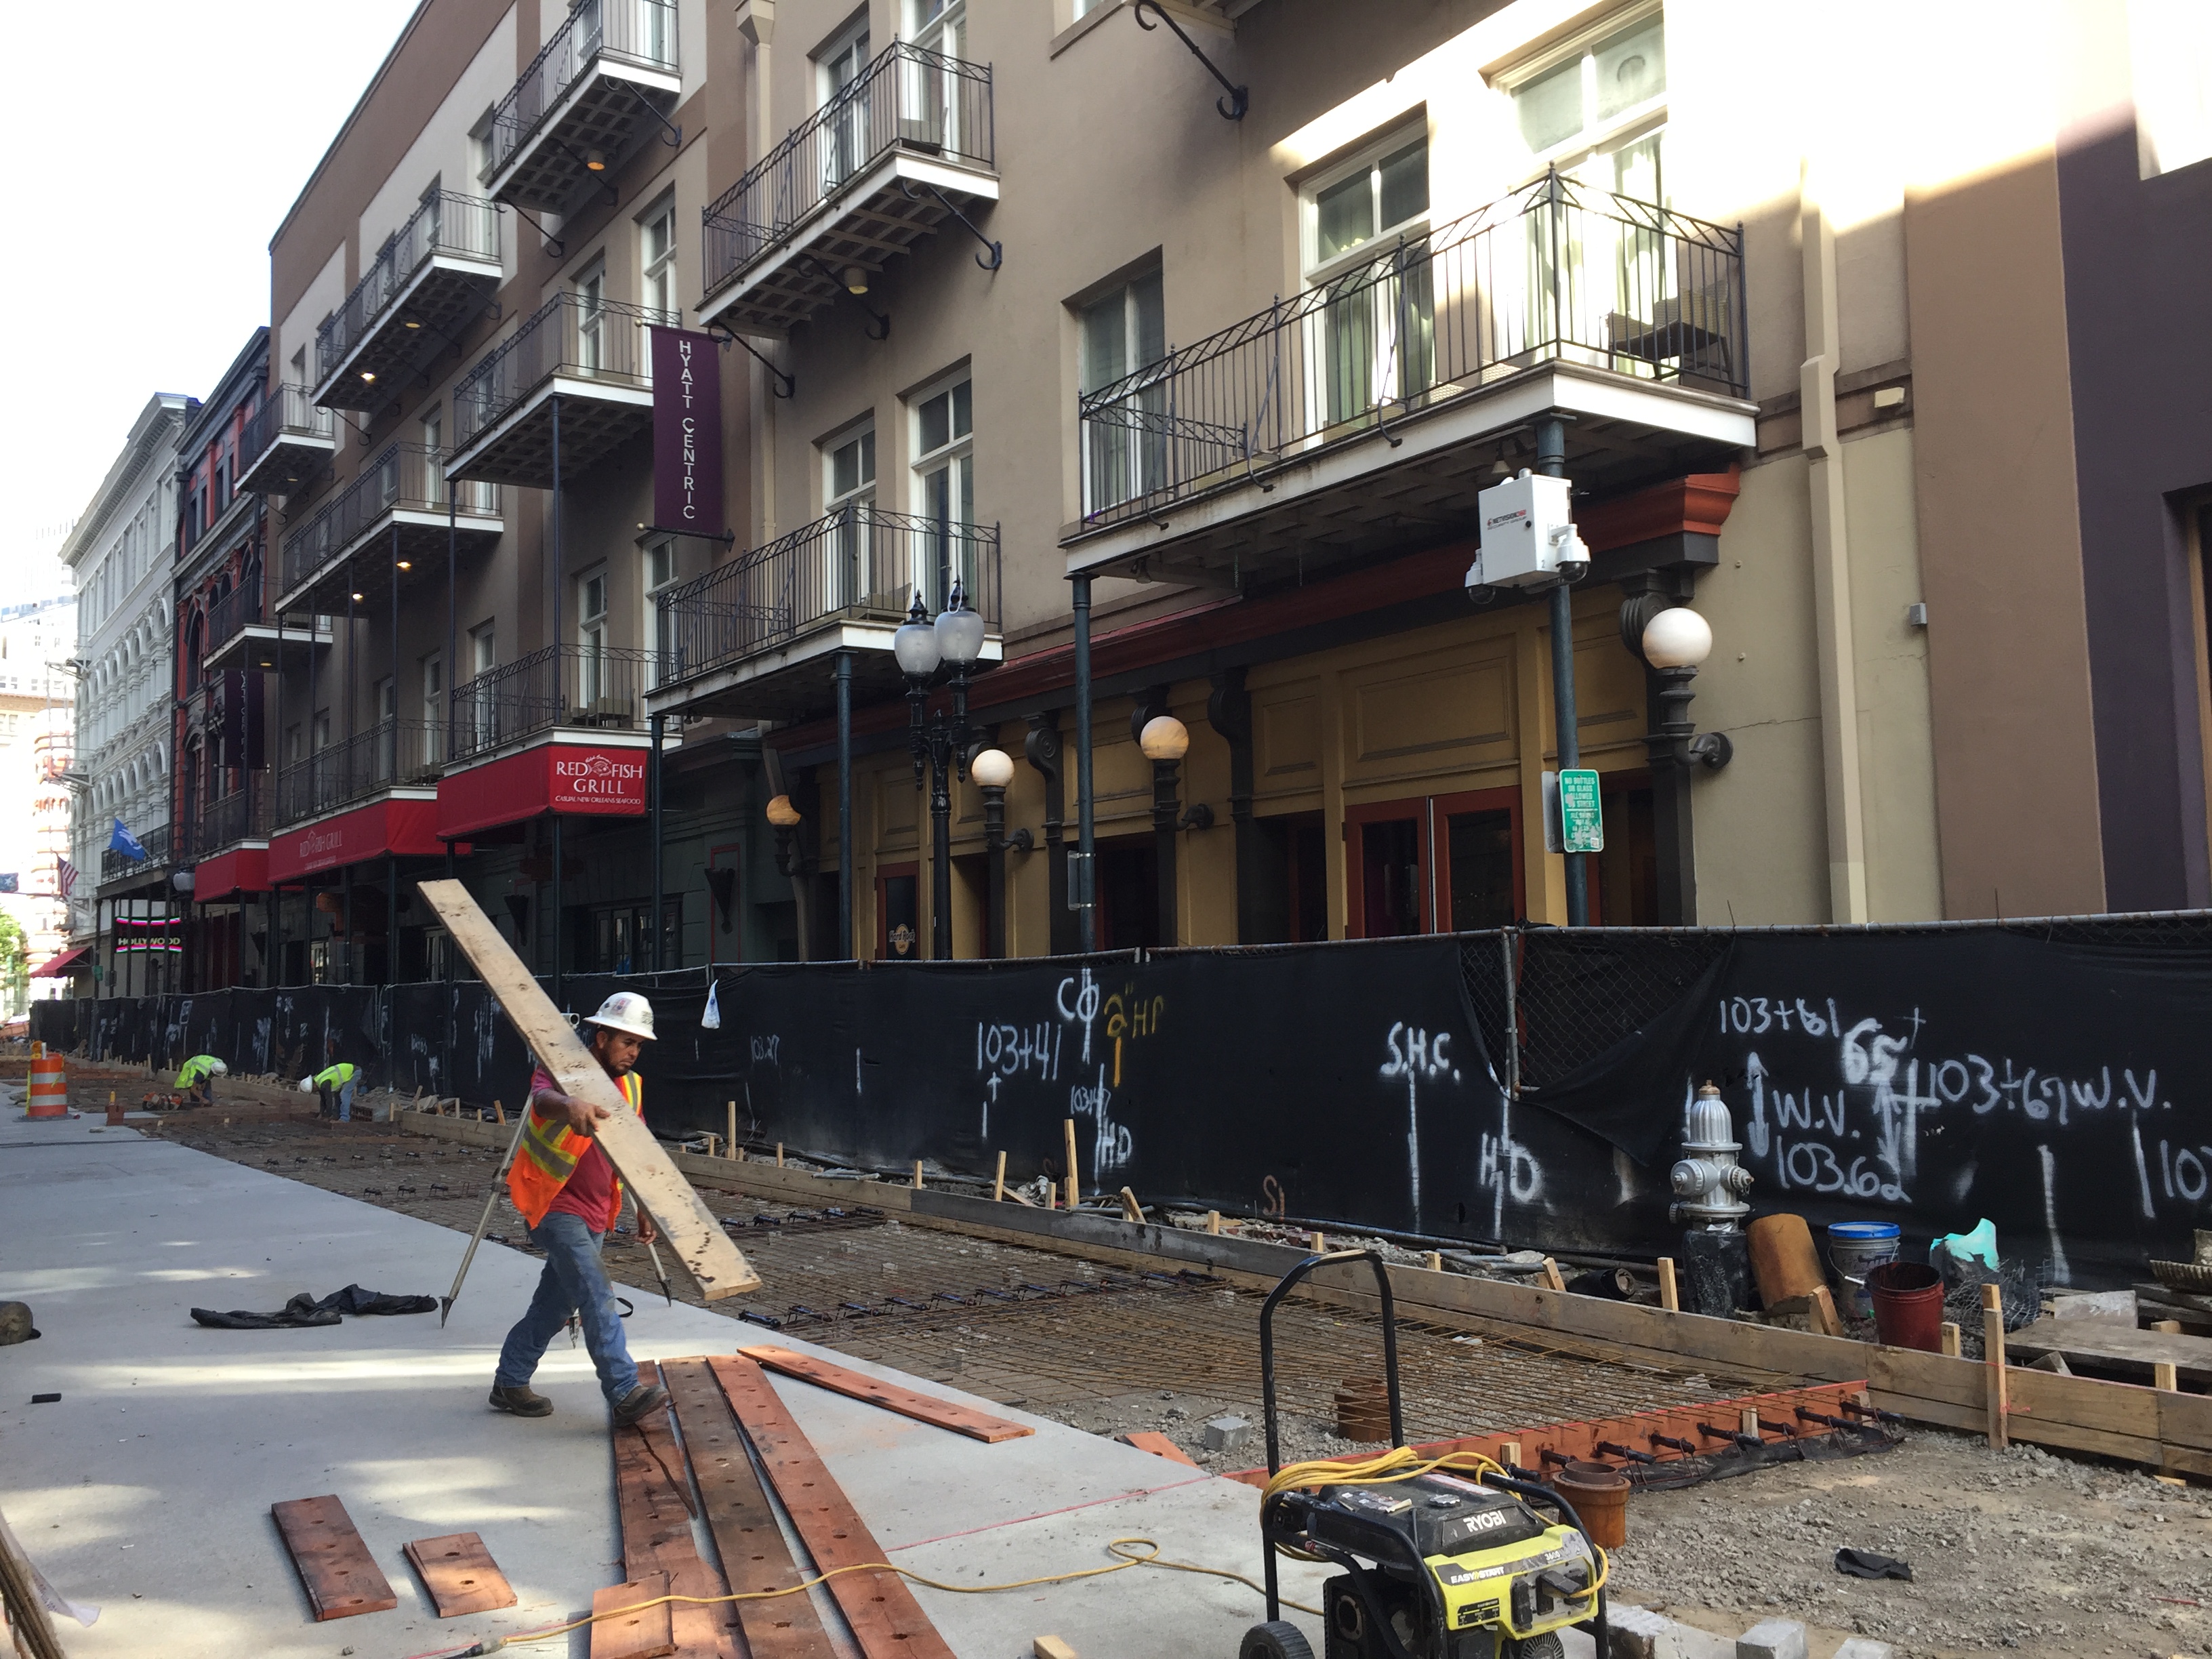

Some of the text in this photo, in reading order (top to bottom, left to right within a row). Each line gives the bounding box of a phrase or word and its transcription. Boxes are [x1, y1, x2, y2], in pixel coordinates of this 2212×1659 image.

[679, 340, 695, 519] HYATT CENTRIC
[556, 761, 643, 779] RED FISH
[573, 778, 625, 794] GRILL
[615, 797, 641, 805] SEAFOOD
[1462, 1510, 1507, 1533] RYOBI
[1544, 1551, 1561, 1561] 3600
[1450, 1566, 1504, 1584] EASY START
